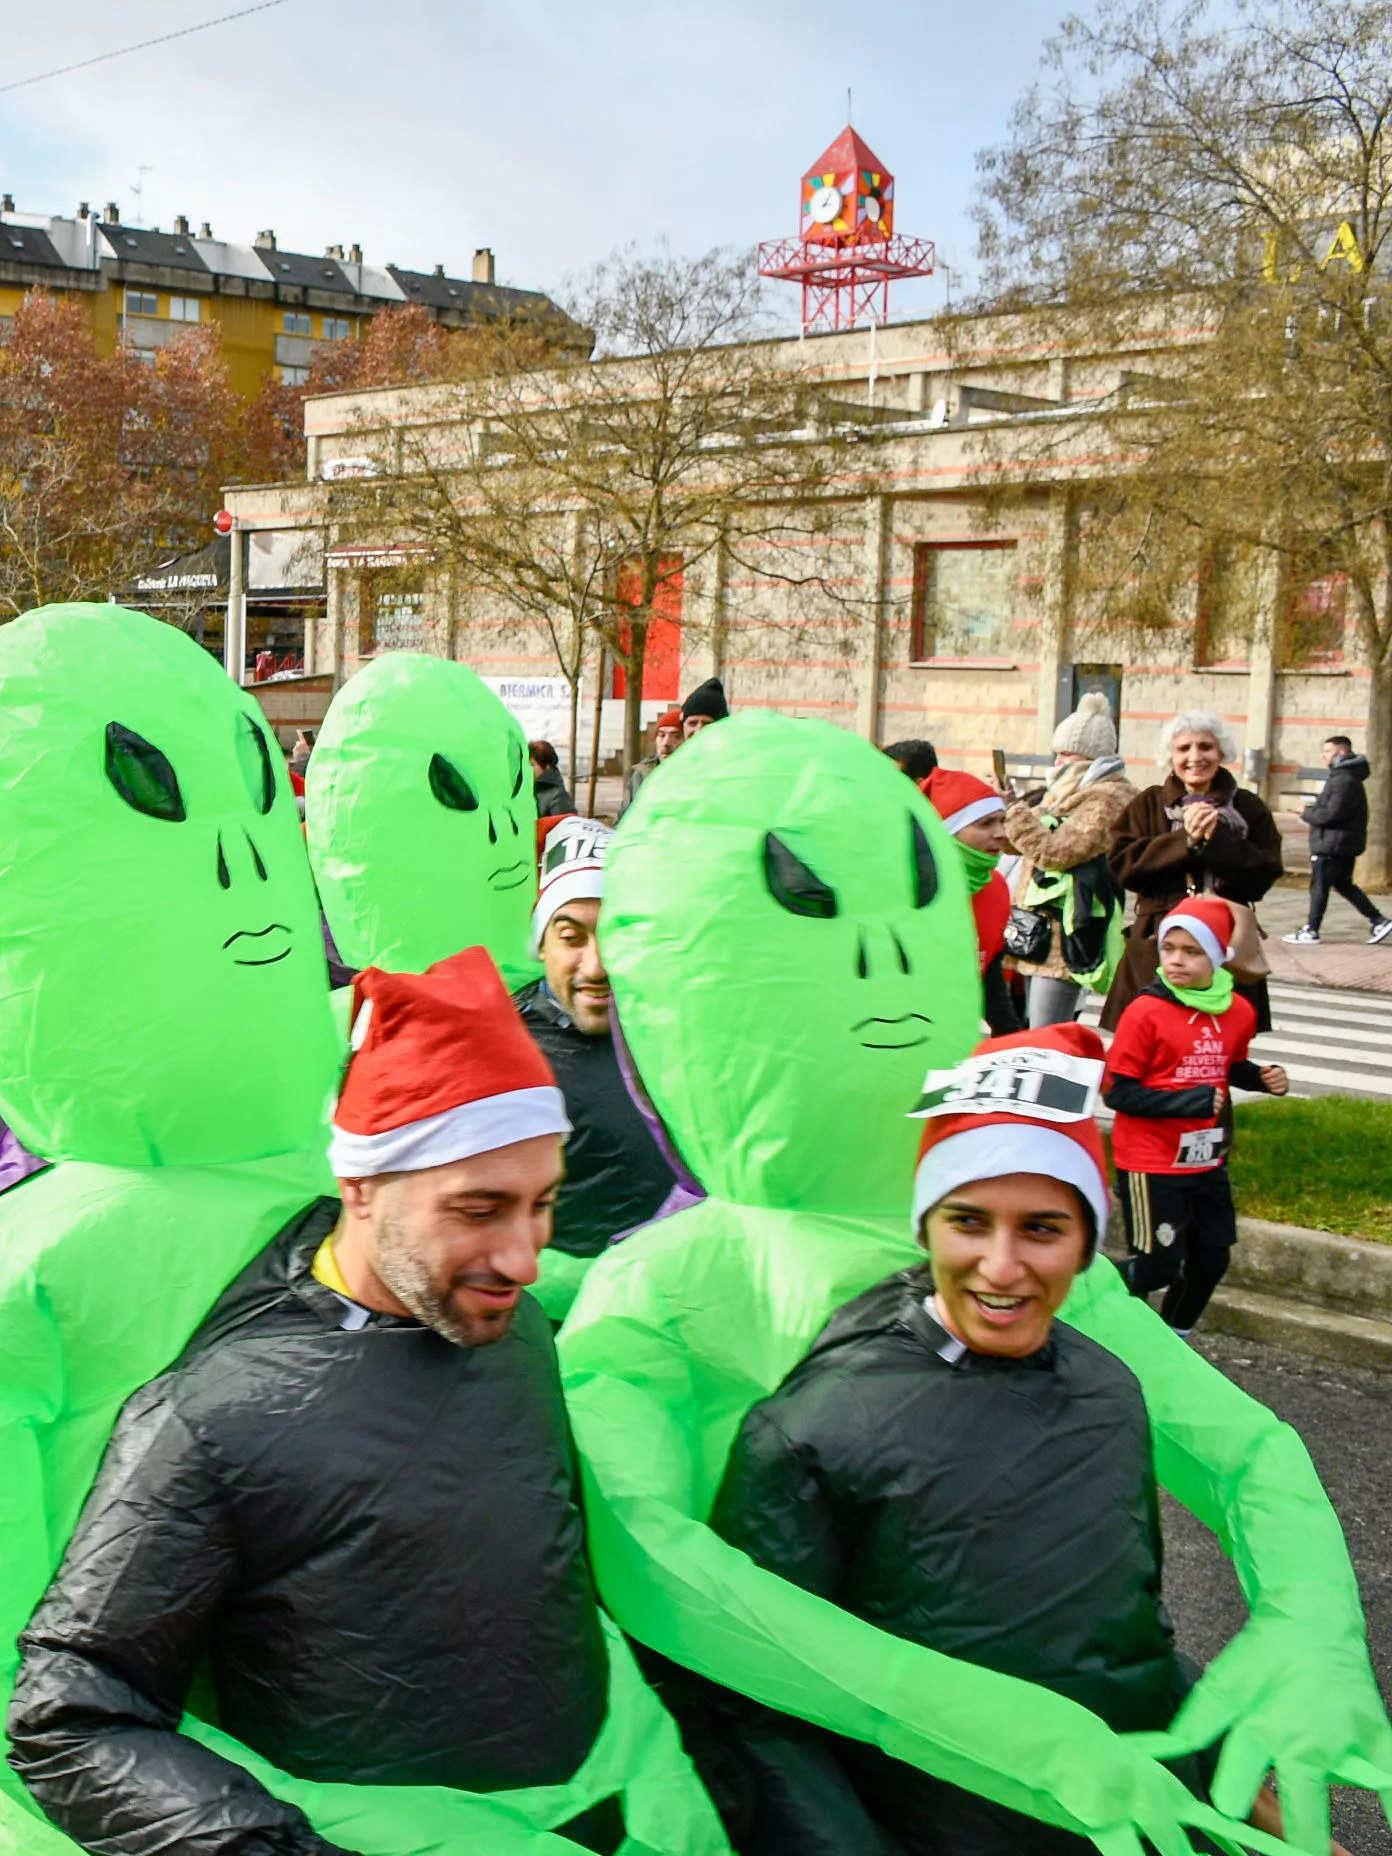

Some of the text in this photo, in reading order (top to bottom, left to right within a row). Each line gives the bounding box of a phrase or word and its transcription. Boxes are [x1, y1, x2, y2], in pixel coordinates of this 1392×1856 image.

[1192, 1041, 1224, 1055] SAN
[943, 1069, 1045, 1103] 341
[1185, 1142, 1214, 1162] 820
